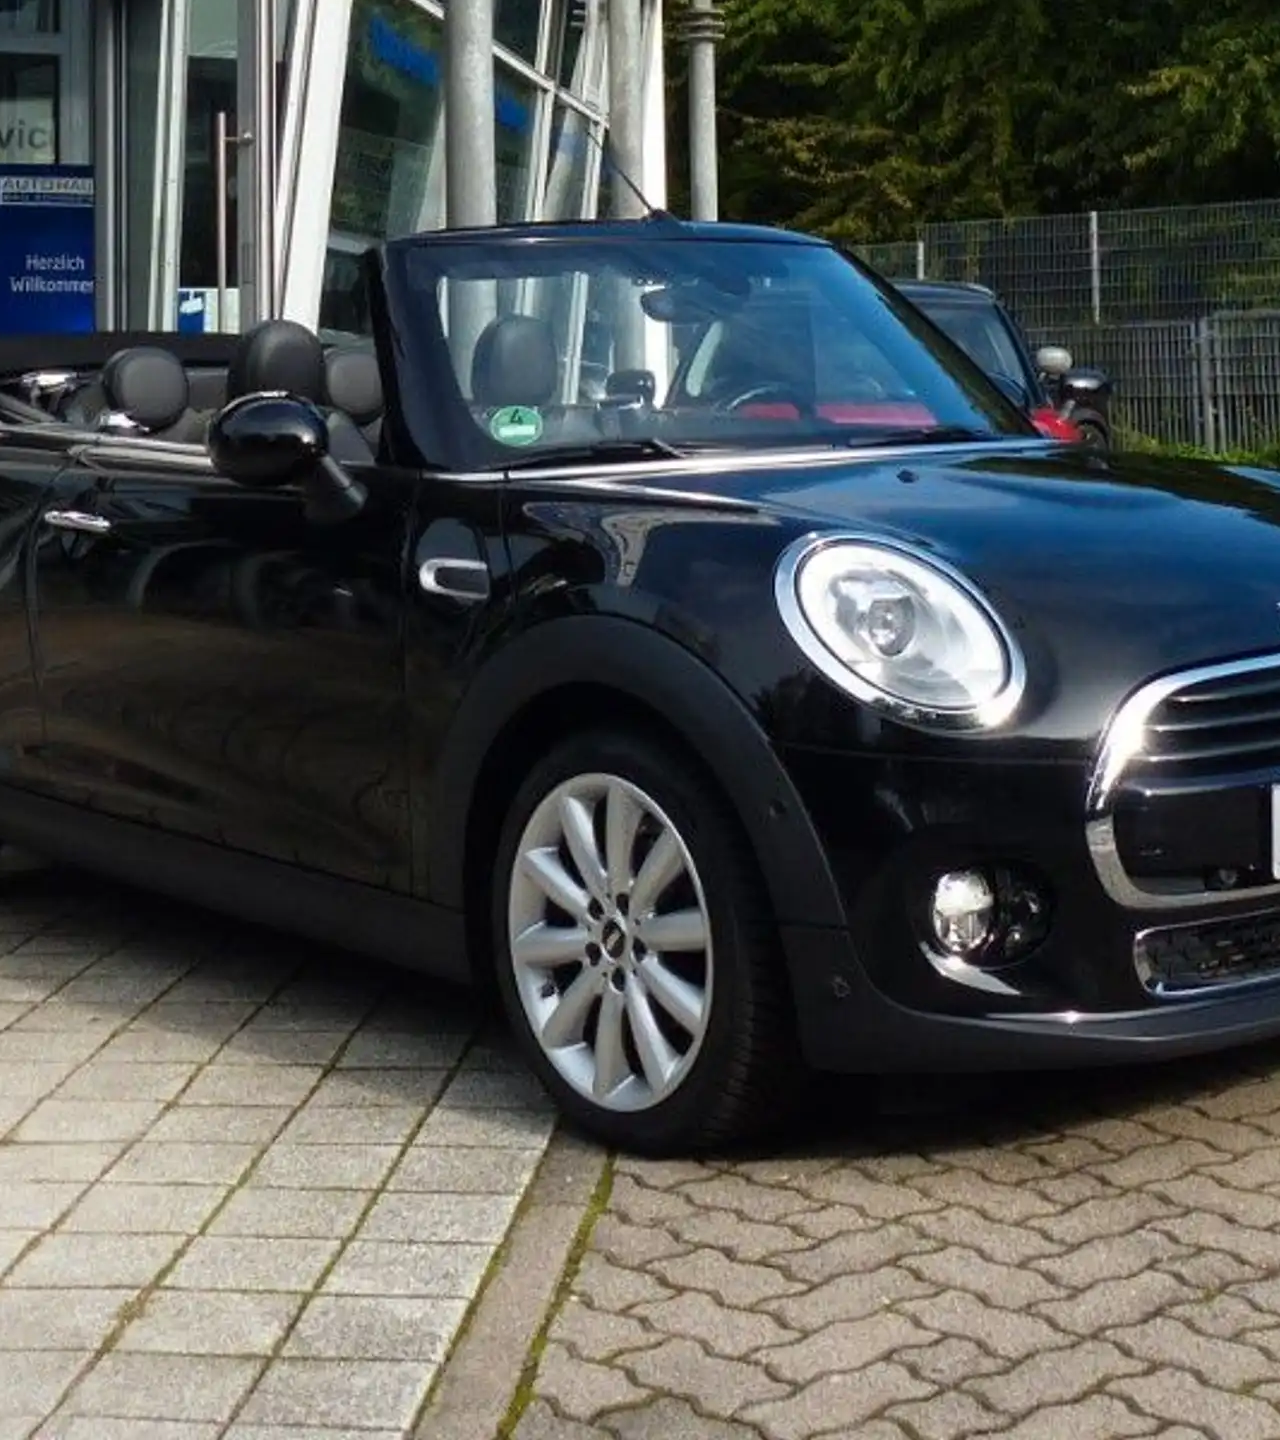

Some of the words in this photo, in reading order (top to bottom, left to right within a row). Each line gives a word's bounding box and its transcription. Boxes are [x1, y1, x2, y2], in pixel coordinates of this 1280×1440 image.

[3, 177, 94, 193] AUTOHAU
[25, 254, 85, 271] Herzlich
[510, 408, 524, 425] 4
